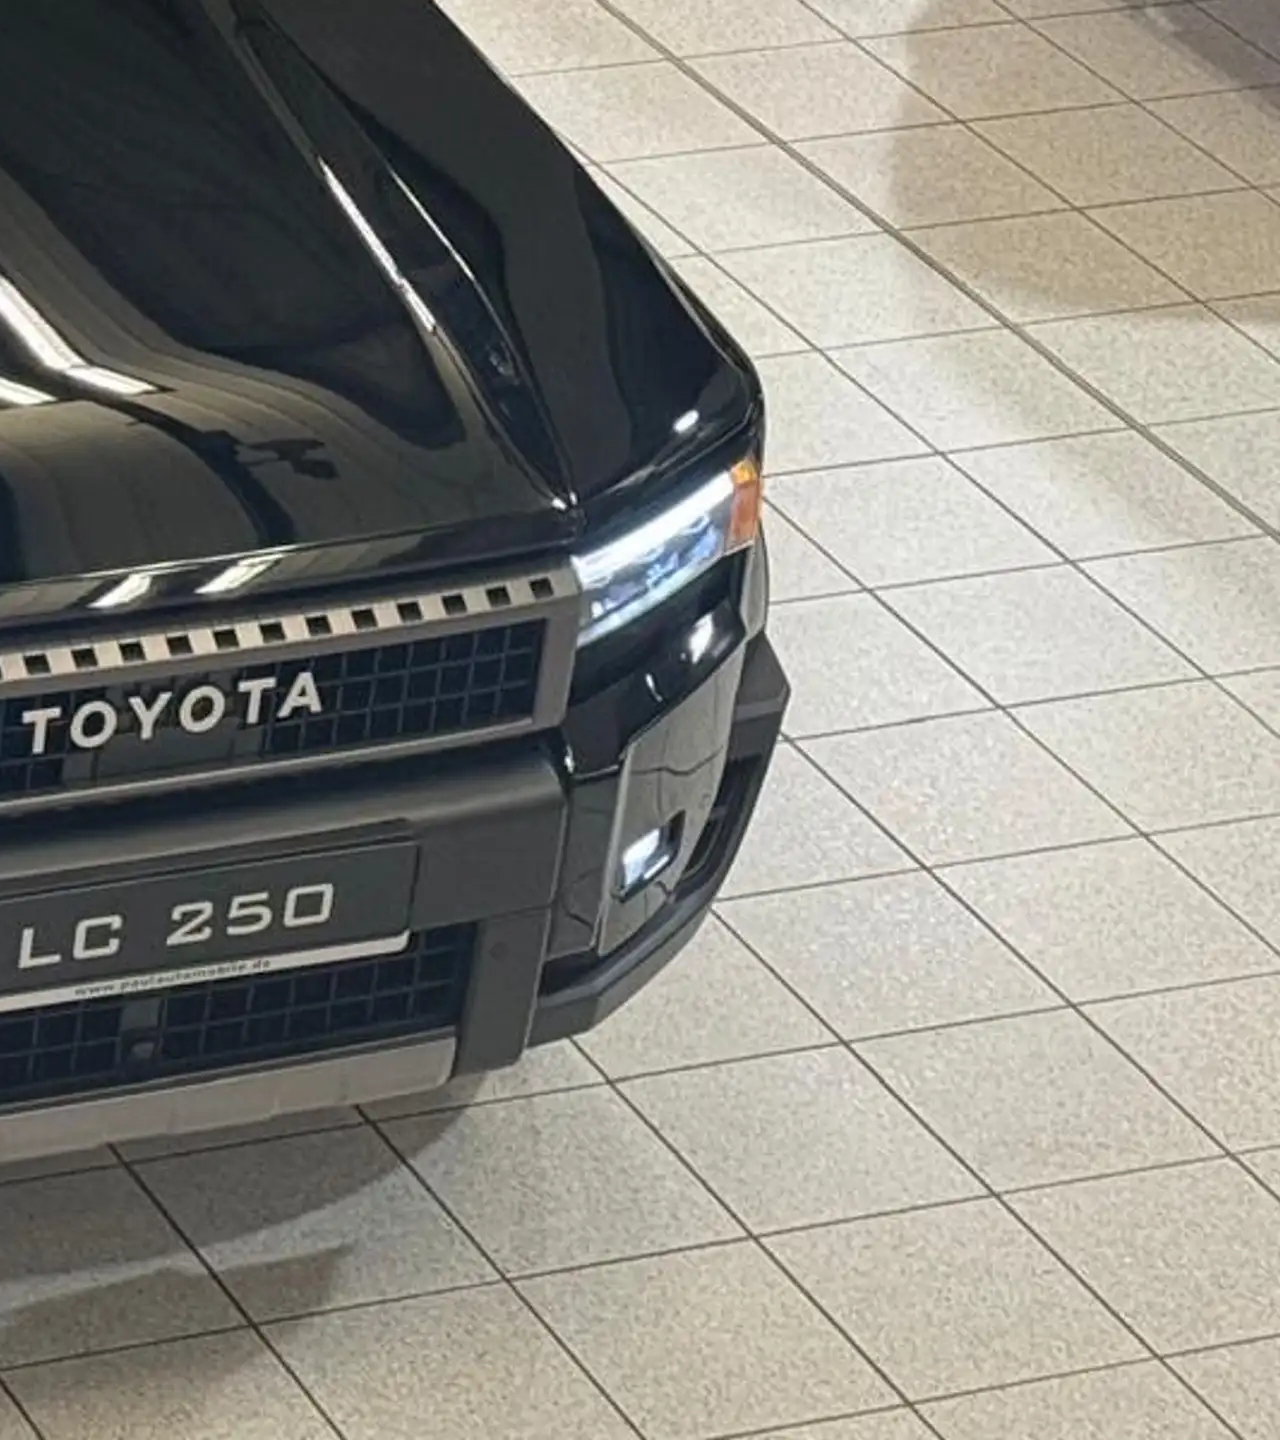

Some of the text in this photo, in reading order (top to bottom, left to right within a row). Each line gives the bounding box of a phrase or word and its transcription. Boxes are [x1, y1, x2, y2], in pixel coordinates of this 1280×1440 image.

[20, 671, 323, 755] TOYOTA
[17, 883, 335, 969] LC 250
